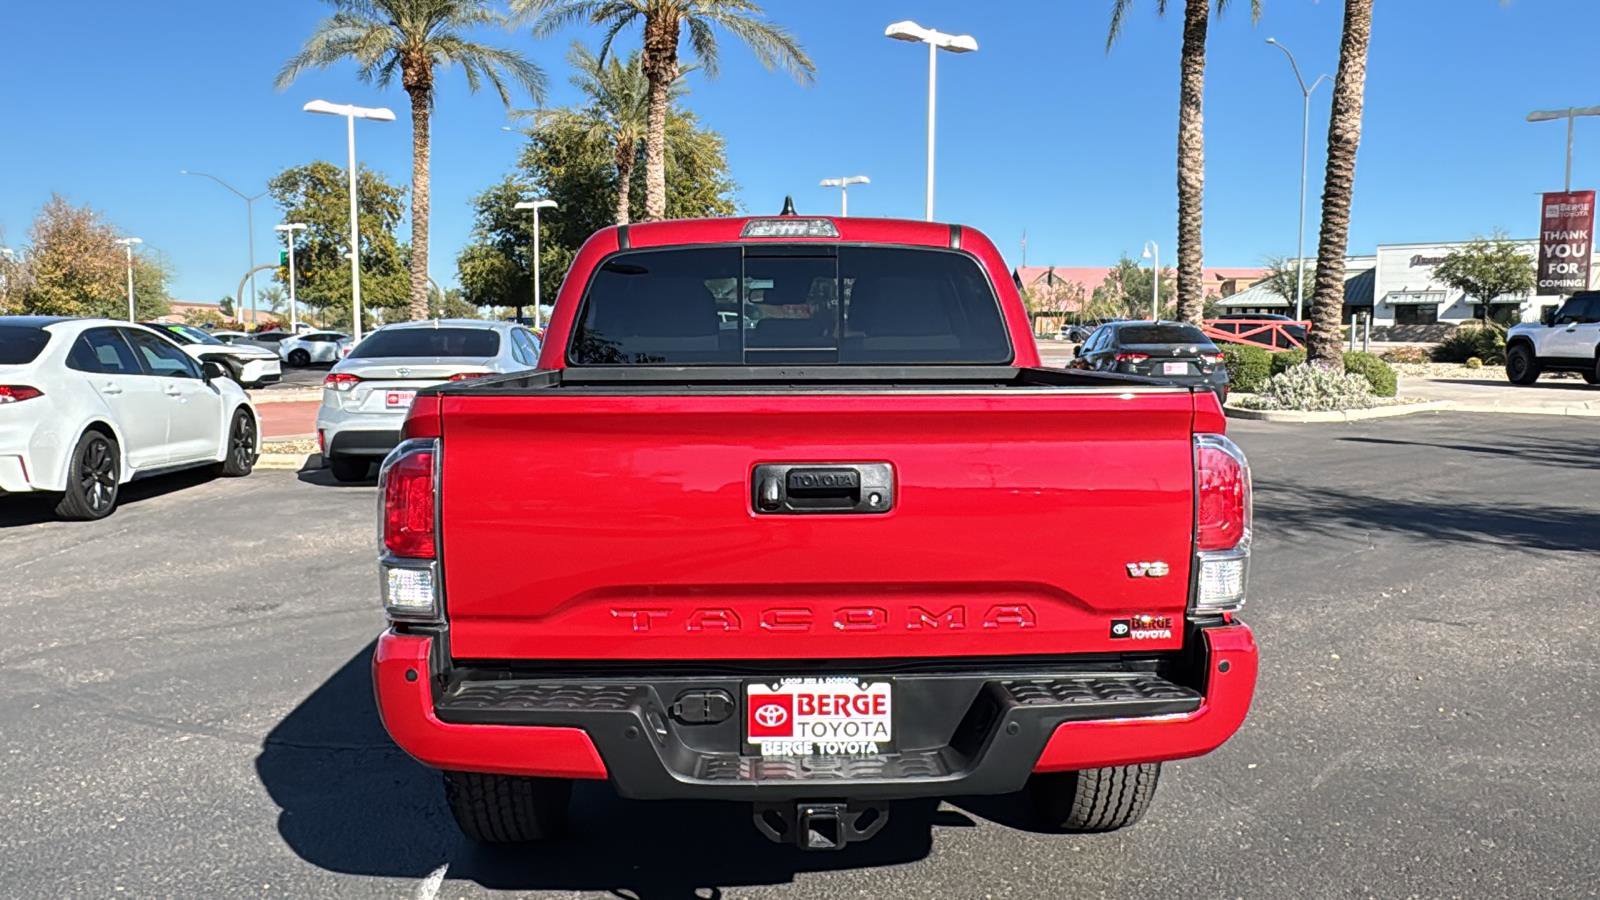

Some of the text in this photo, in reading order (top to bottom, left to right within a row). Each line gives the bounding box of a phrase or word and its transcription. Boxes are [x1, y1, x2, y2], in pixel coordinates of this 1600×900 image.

[1543, 230, 1588, 241] THANK
[1543, 242, 1586, 258] YOU
[1548, 262, 1579, 275] FOR
[1539, 278, 1586, 288] COMING!
[792, 473, 856, 487] TOYOTA
[1125, 561, 1169, 578] V6
[610, 605, 1038, 632] TACOMA
[1130, 629, 1172, 640] TOYOTA
[797, 693, 887, 718] BERGE
[797, 721, 888, 738] TOYOTA
[761, 740, 879, 757] BERGE TOYOTA
